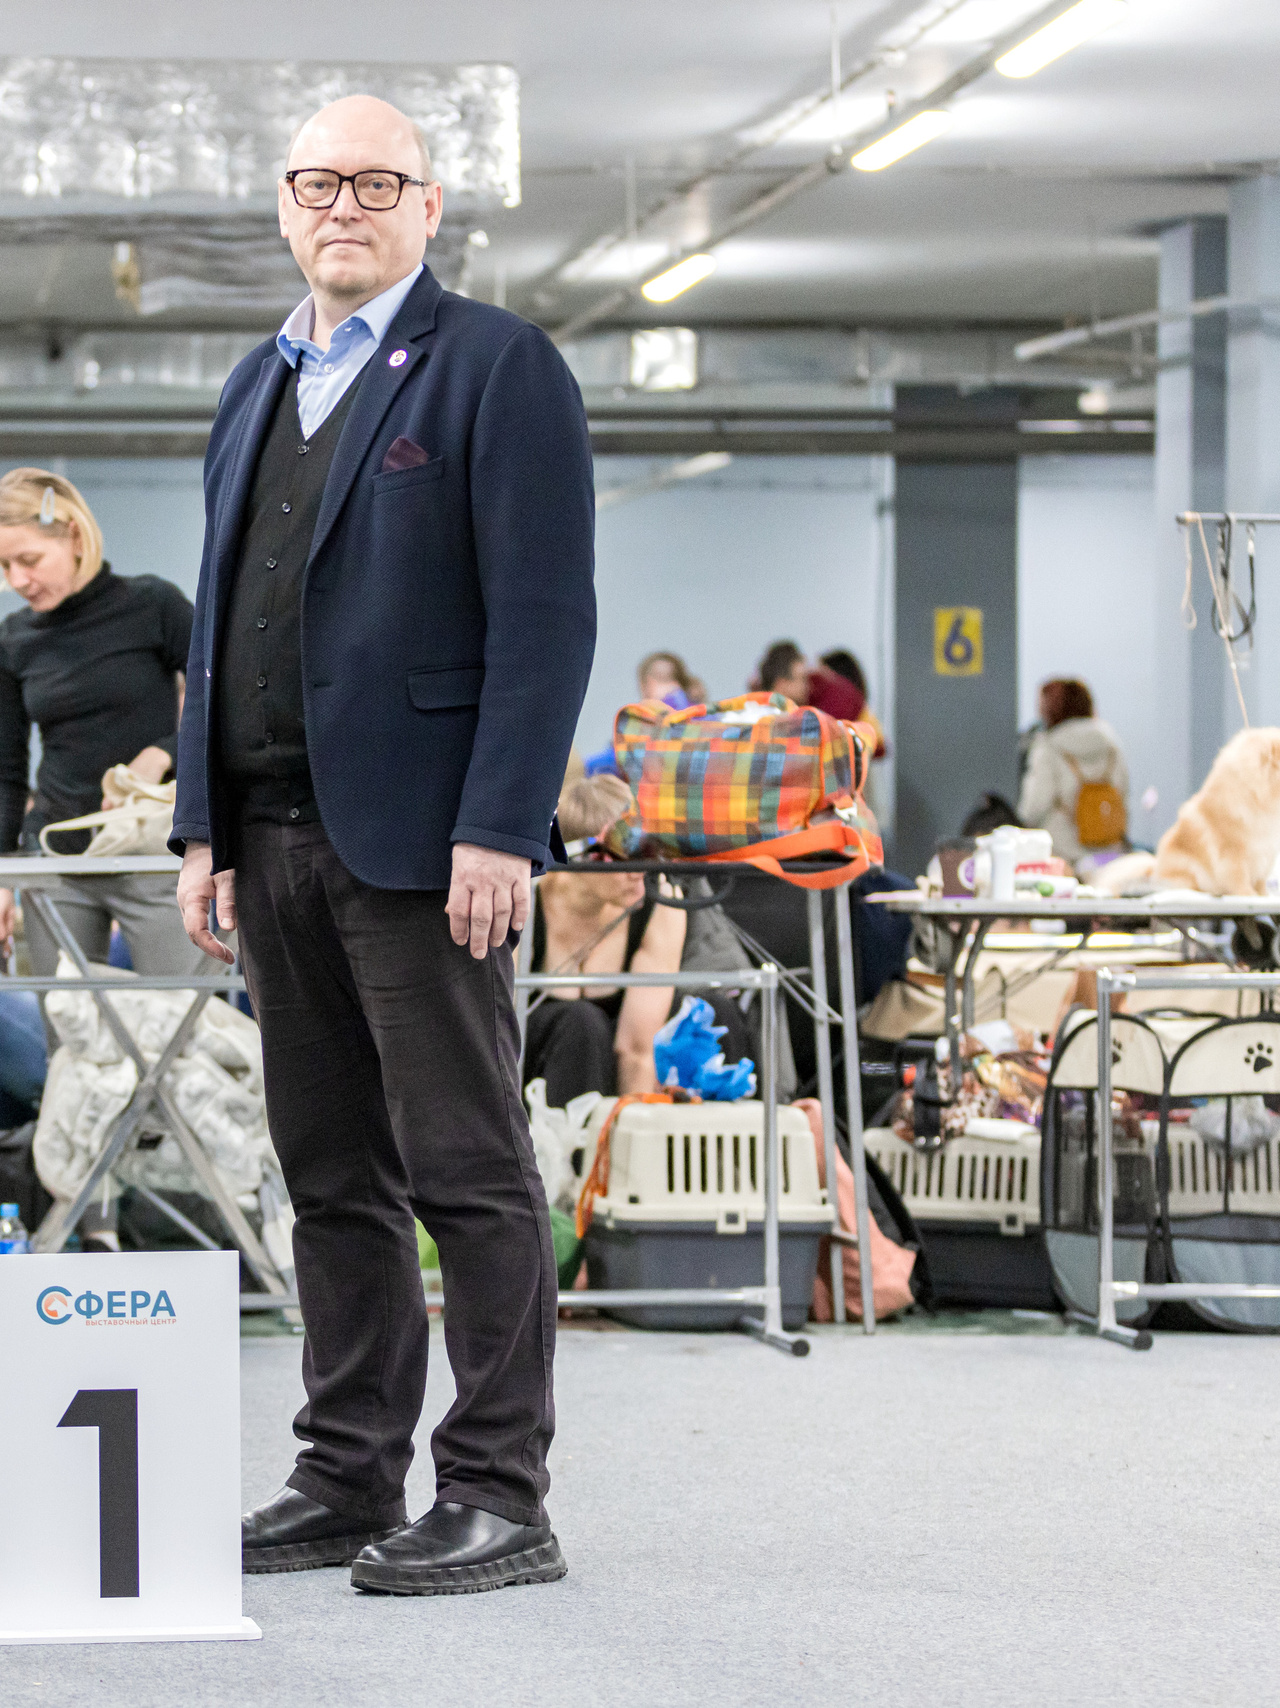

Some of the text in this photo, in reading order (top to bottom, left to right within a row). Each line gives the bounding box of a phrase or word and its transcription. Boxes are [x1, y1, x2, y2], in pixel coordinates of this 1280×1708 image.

[943, 609, 973, 668] 6
[36, 1285, 177, 1326] СФЕРА
[85, 1317, 177, 1327] ВЫСТАВОЧНЫЙ ЦЕНТР
[56, 1388, 140, 1599] 1
